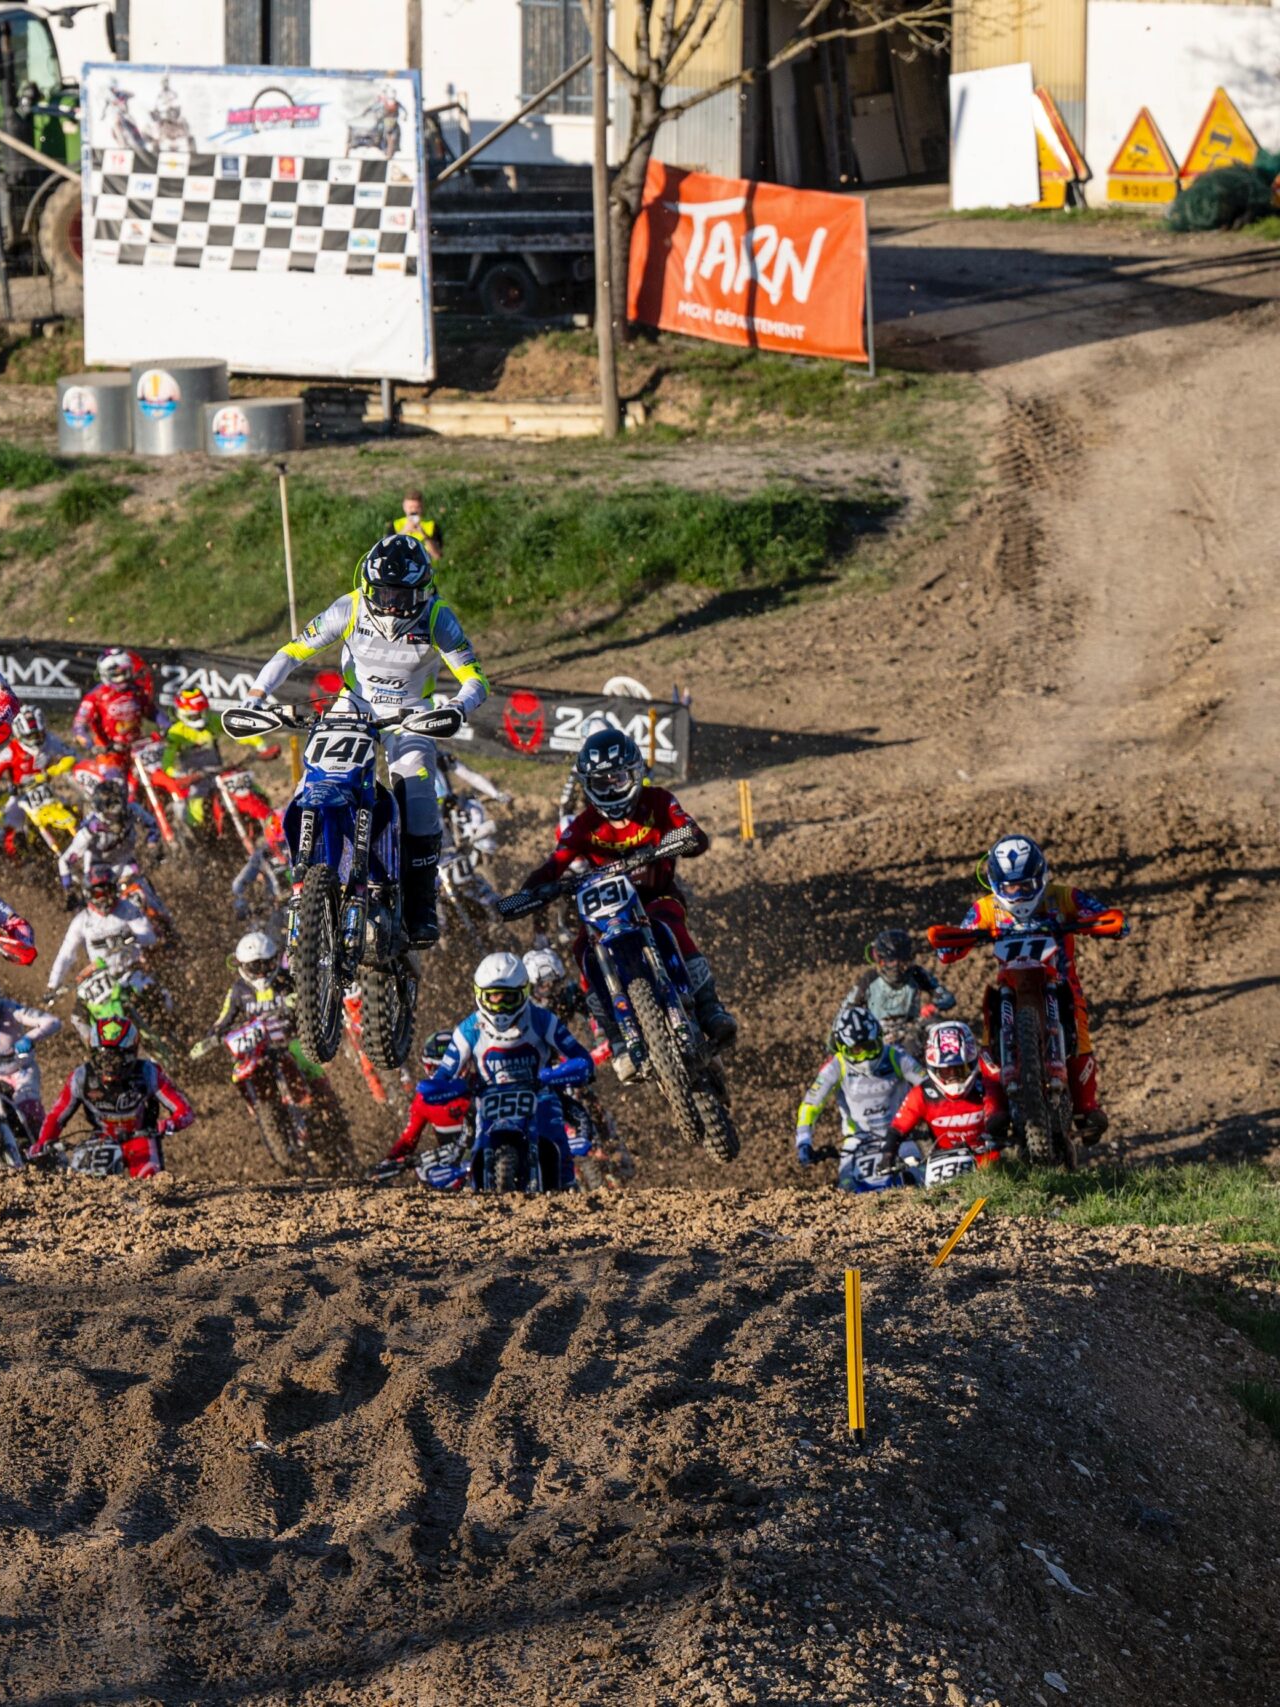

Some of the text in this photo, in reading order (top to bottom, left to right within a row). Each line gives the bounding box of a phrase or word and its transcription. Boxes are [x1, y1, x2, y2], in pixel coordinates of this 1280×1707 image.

[663, 196, 828, 306] TARN
[677, 301, 806, 341] MON DÉPARTEMENT
[367, 674, 409, 690] Dafy
[310, 736, 373, 764] 141
[582, 877, 629, 917] 831
[1004, 938, 1047, 962] 11
[486, 1055, 538, 1071] YAMAHA
[483, 1091, 536, 1118] 259
